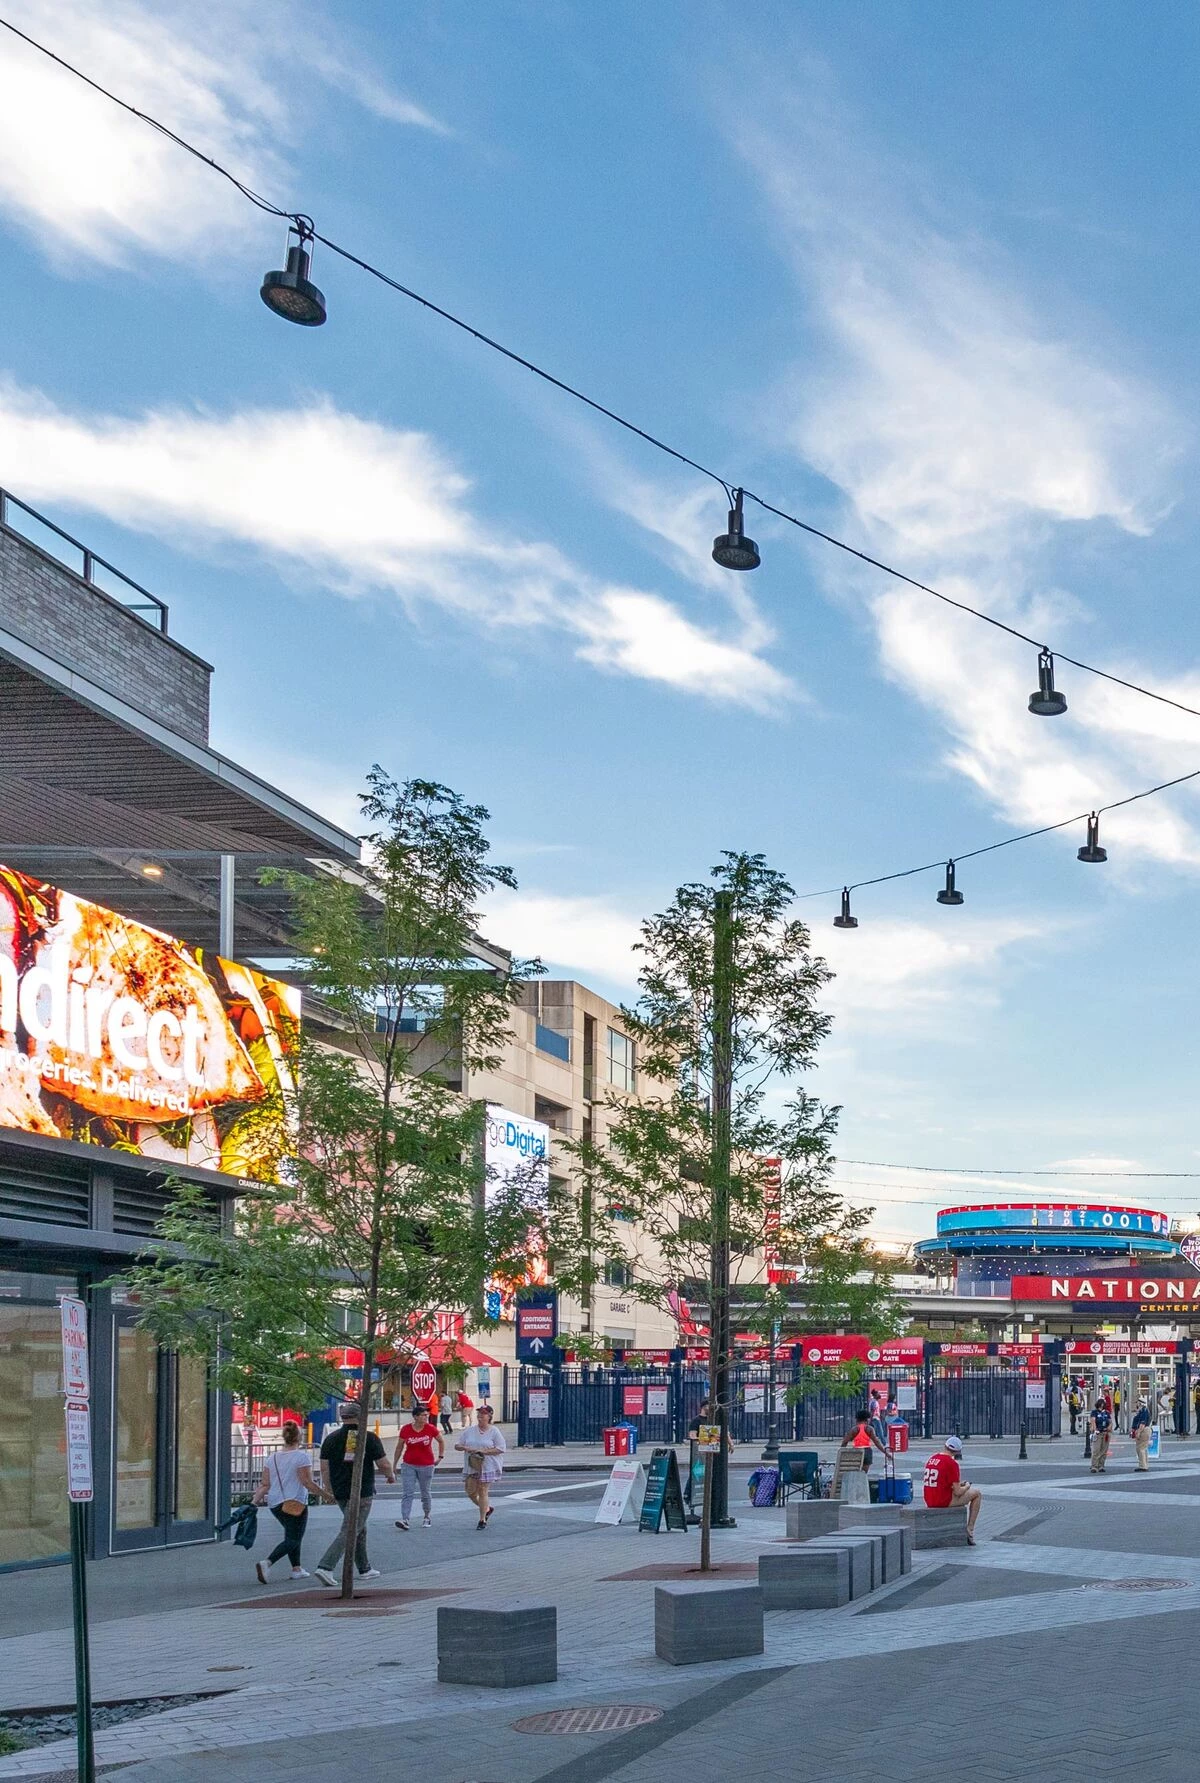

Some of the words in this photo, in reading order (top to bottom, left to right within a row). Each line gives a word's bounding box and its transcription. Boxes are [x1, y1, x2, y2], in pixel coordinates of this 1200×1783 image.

[0, 1048, 97, 1090] roceries.
[102, 1067, 194, 1116] Delivered.
[1102, 1213, 1113, 1227] 0
[1120, 1214, 1130, 1227] 0
[1136, 1216, 1142, 1229] 1
[609, 1301, 626, 1313] GARAGE
[626, 1304, 631, 1314] C
[1140, 1304, 1189, 1312] CENTER
[69, 1307, 79, 1327] NO
[64, 1328, 86, 1349] PARKING
[414, 1373, 434, 1389] STOP
[923, 1468, 939, 1488] 22
